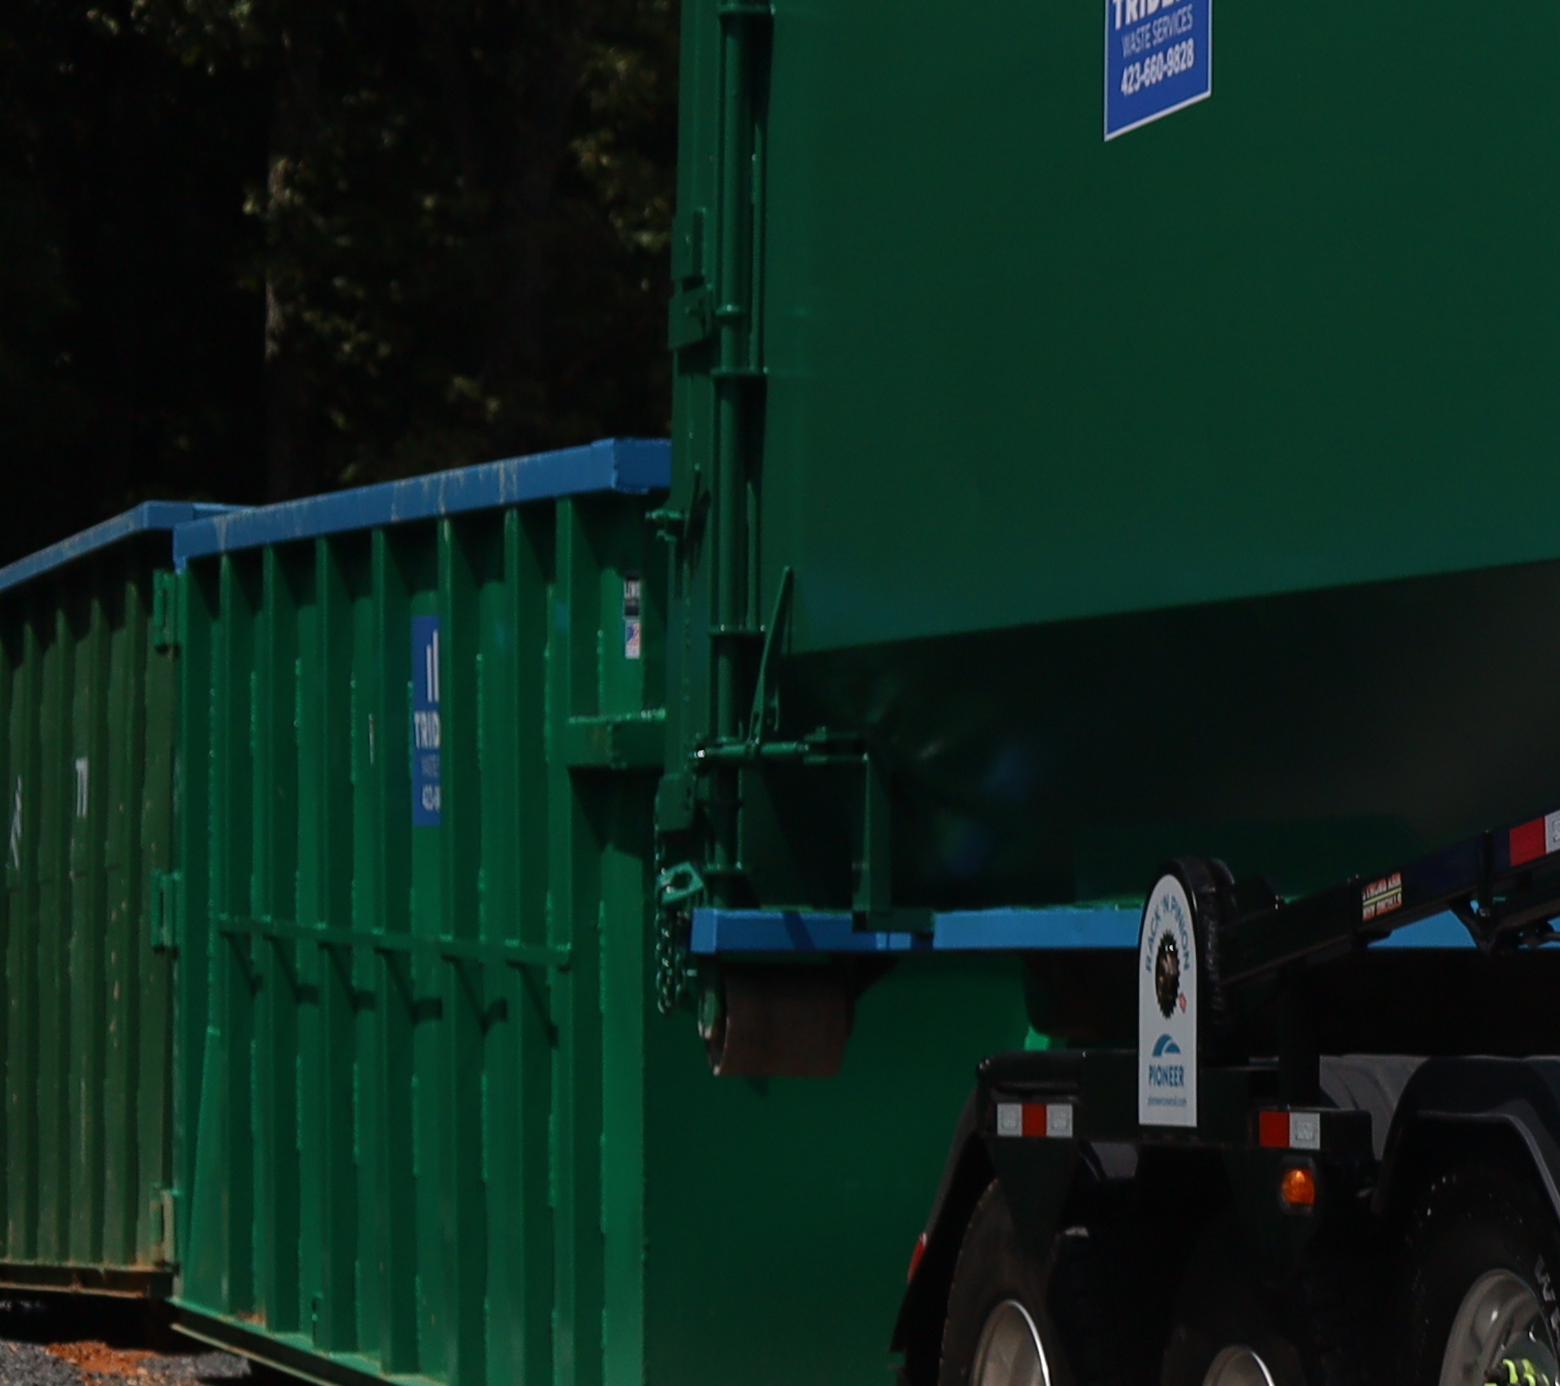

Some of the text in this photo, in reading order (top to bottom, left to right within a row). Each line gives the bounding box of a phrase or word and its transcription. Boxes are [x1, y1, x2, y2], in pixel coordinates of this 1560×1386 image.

[1122, 5, 1193, 58] WASTE SERVICES
[1121, 38, 1194, 96] 423-660-9828
[1149, 1065, 1185, 1087] PIONEER
